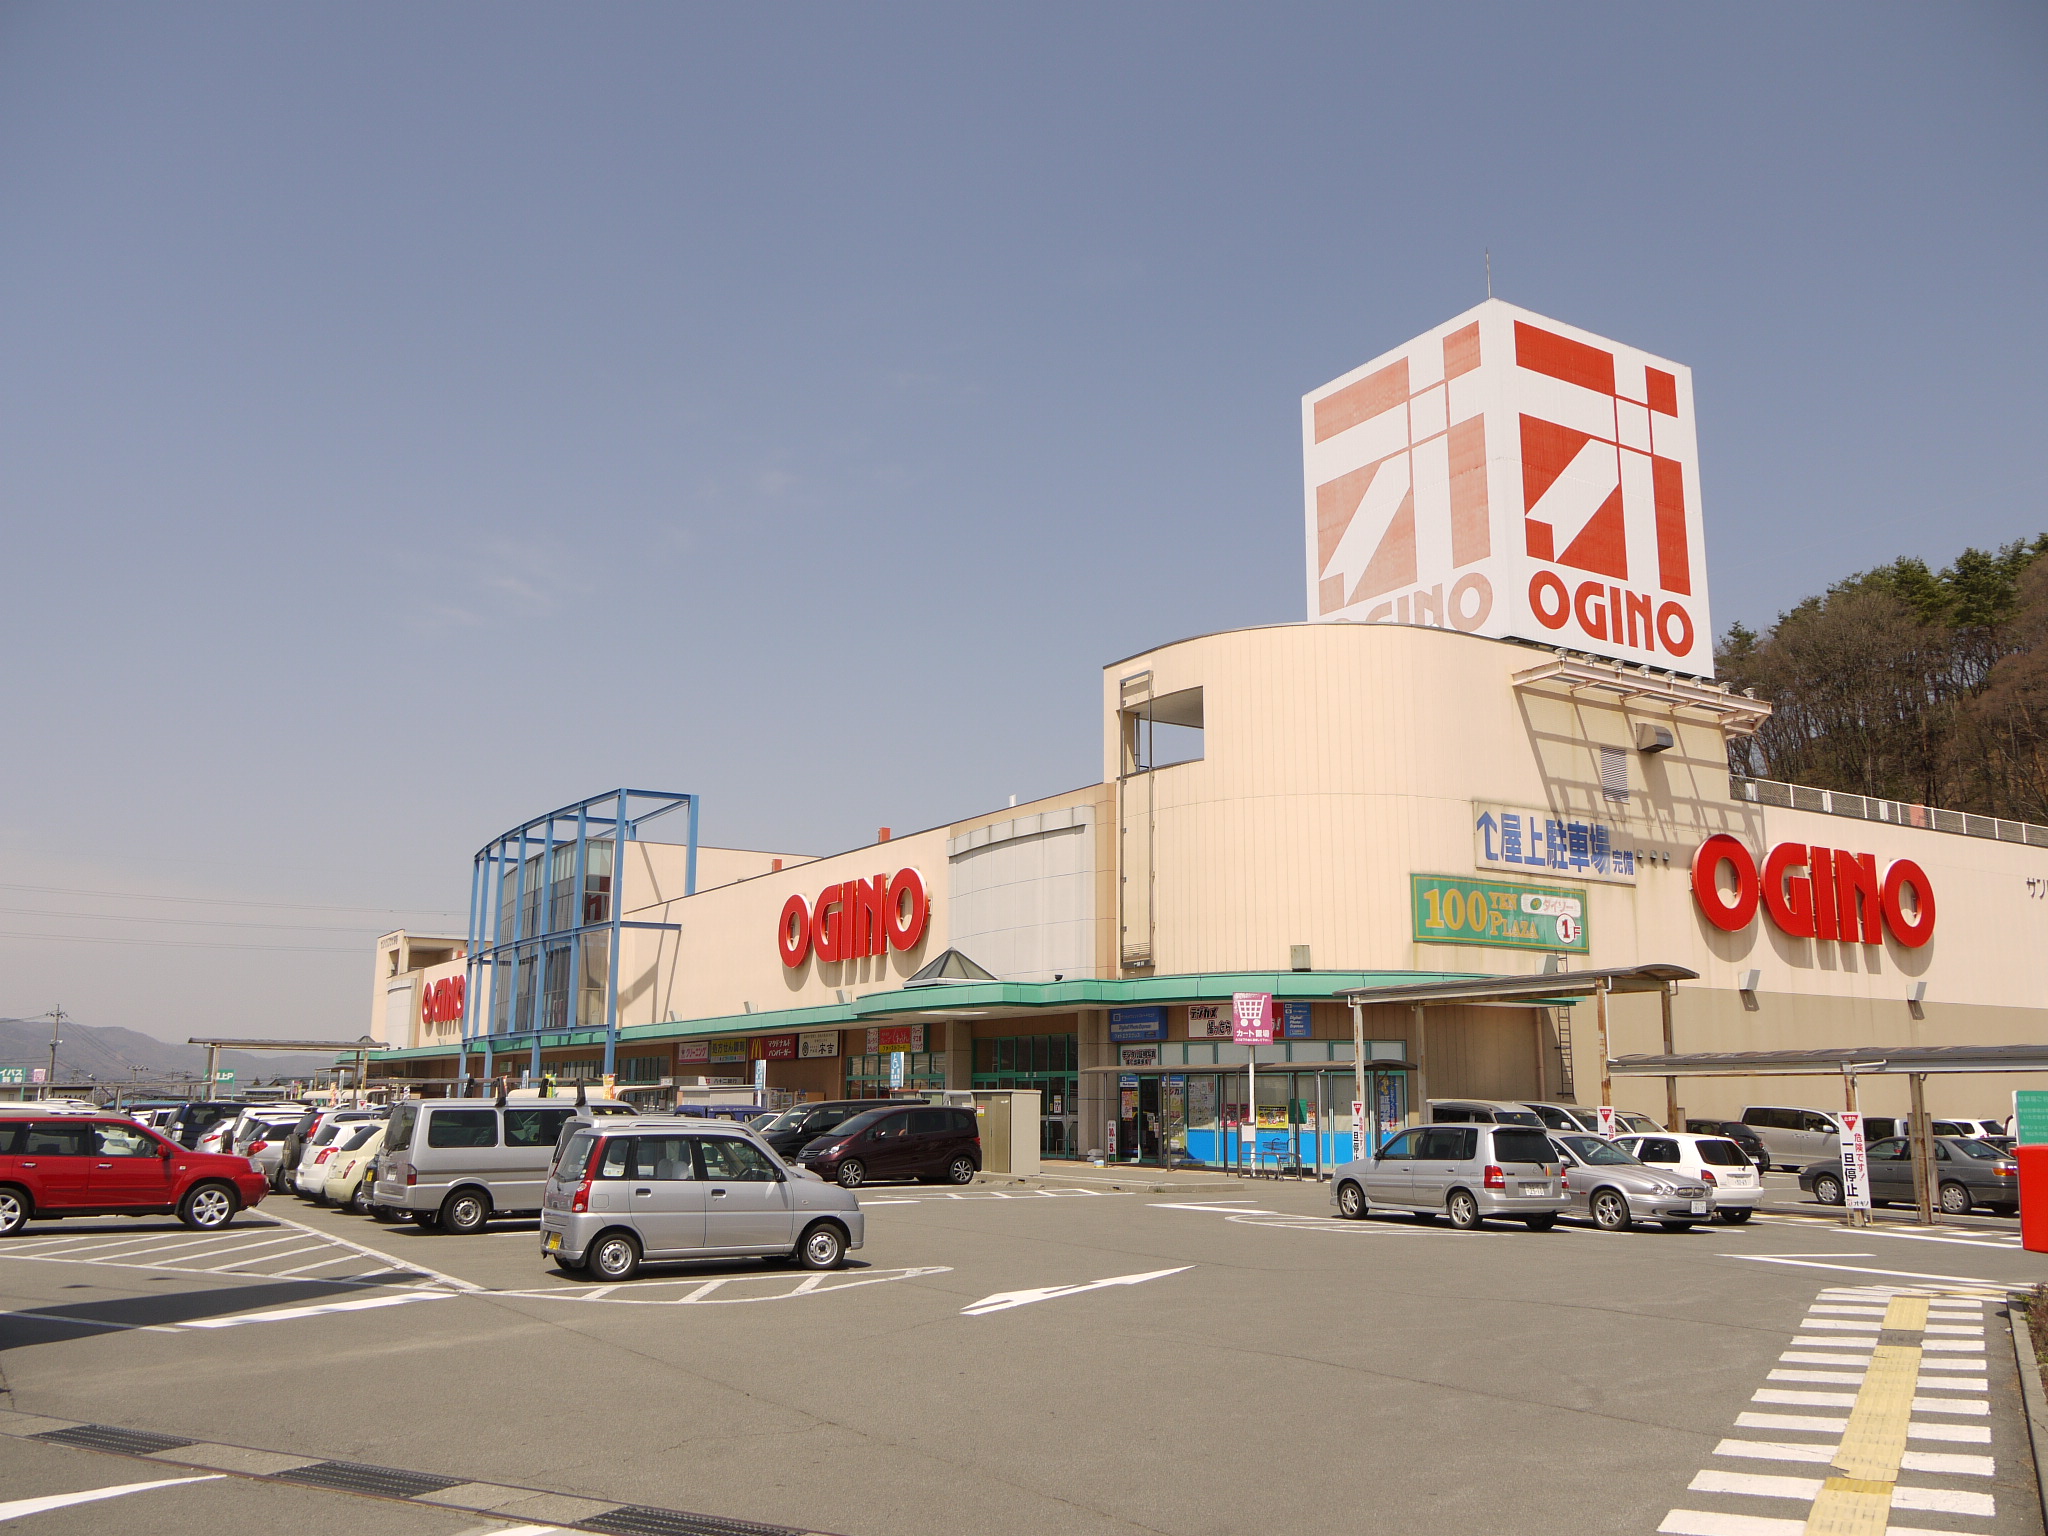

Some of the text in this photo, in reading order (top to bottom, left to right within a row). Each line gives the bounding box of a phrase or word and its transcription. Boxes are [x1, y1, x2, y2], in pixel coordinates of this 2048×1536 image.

[1333, 573, 1493, 633] INO
[1528, 570, 1694, 657] OGINO
[1500, 813, 1611, 875] 屋上駐車場
[1423, 888, 1518, 932] 100 YEN
[1692, 833, 1936, 948] OGINO
[778, 867, 929, 968] OGINO
[1488, 911, 1539, 939] PLAZA
[422, 975, 466, 1024] OGINO
[1190, 1006, 1218, 1019] デジカメ
[768, 1039, 791, 1047] マクドナルド
[768, 1049, 792, 1057] ハンバーガー
[1842, 1142, 1859, 1197] 一旦停止
[1854, 1132, 1866, 1182] 危険です!
